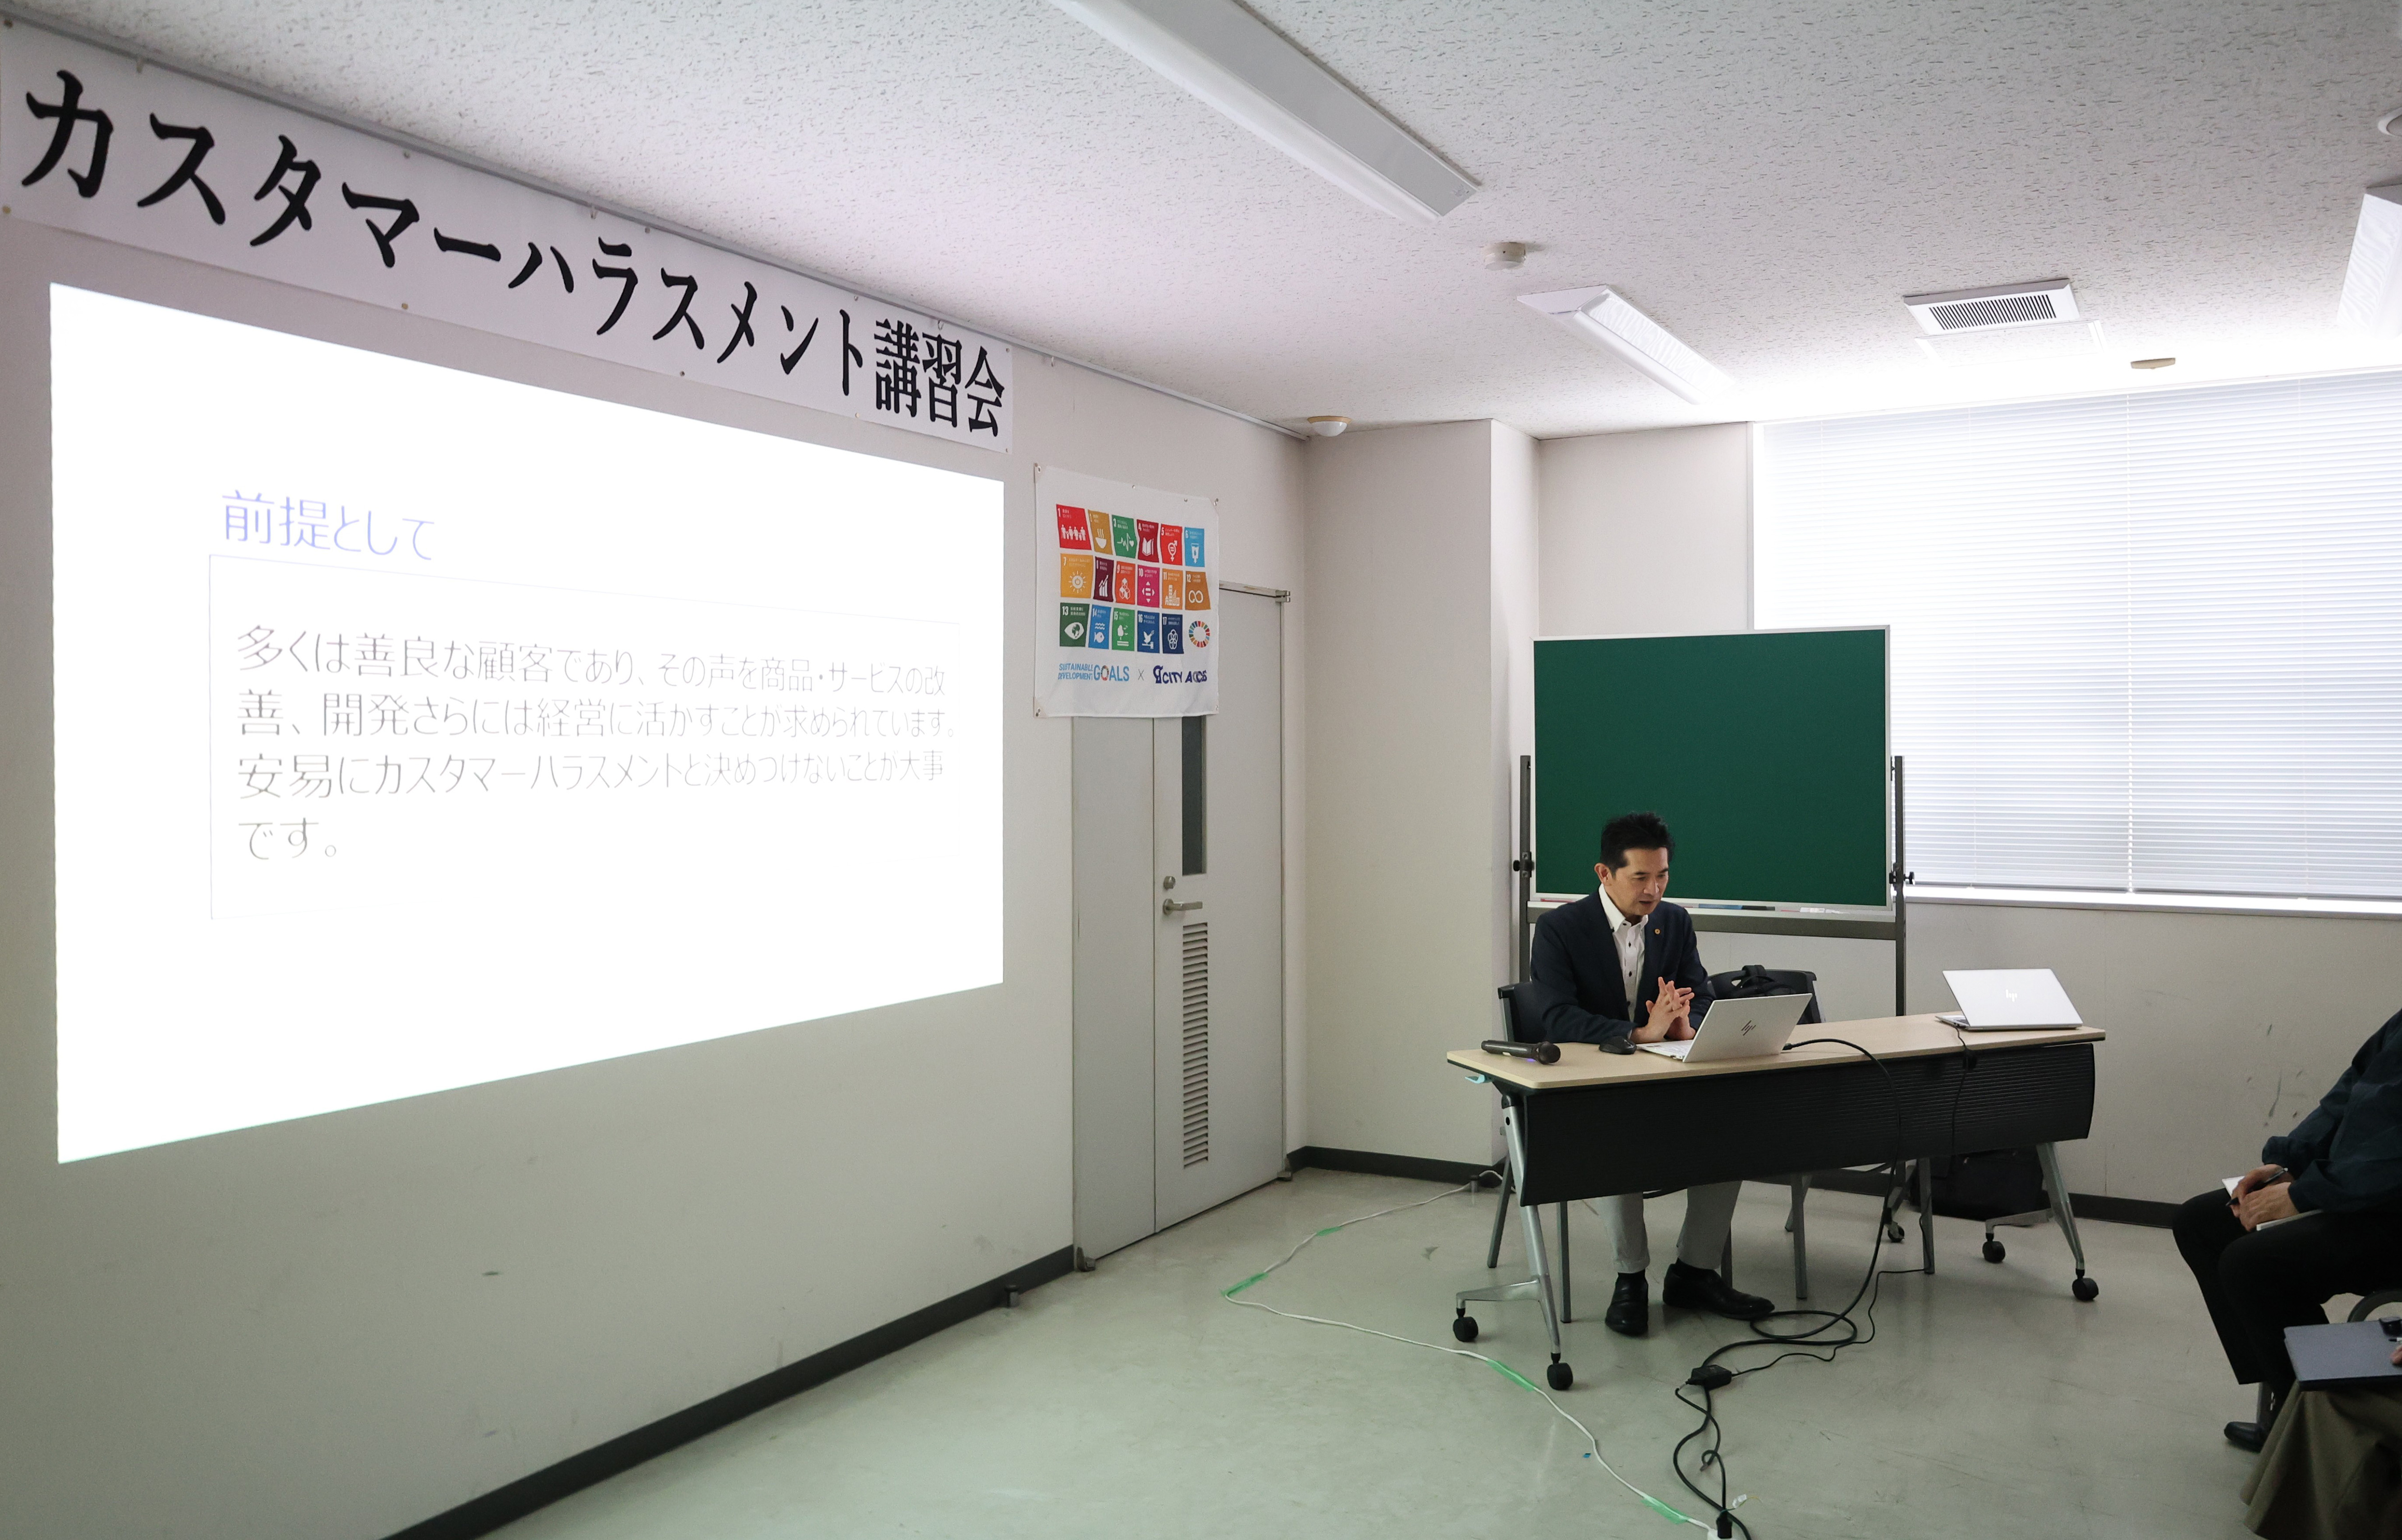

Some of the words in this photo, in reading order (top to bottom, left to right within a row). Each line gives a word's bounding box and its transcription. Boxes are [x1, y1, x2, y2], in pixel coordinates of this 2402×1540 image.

[21, 69, 1005, 437] カスタマーハラスメント講習会
[1058, 508, 1061, 517] 1
[222, 489, 435, 561] 前提として
[1138, 522, 1142, 531] 4
[1161, 527, 1164, 536] 5
[1185, 530, 1188, 538] 6
[1063, 556, 1066, 566] 7
[1117, 564, 1120, 573] 9
[1139, 568, 1144, 577] 10
[1163, 572, 1167, 580] 11
[1186, 574, 1191, 582] 12
[1062, 606, 1069, 615] 13
[1093, 608, 1097, 617] 14
[1114, 611, 1118, 620] 15
[1138, 614, 1143, 623] 16
[1162, 616, 1167, 625] 17
[1093, 665, 1130, 682] GOALS
[1162, 671, 1182, 683] CITY
[238, 749, 944, 799] 安易にカスタマーハラスメントと決めつけないことが大事
[238, 816, 337, 861] です。
